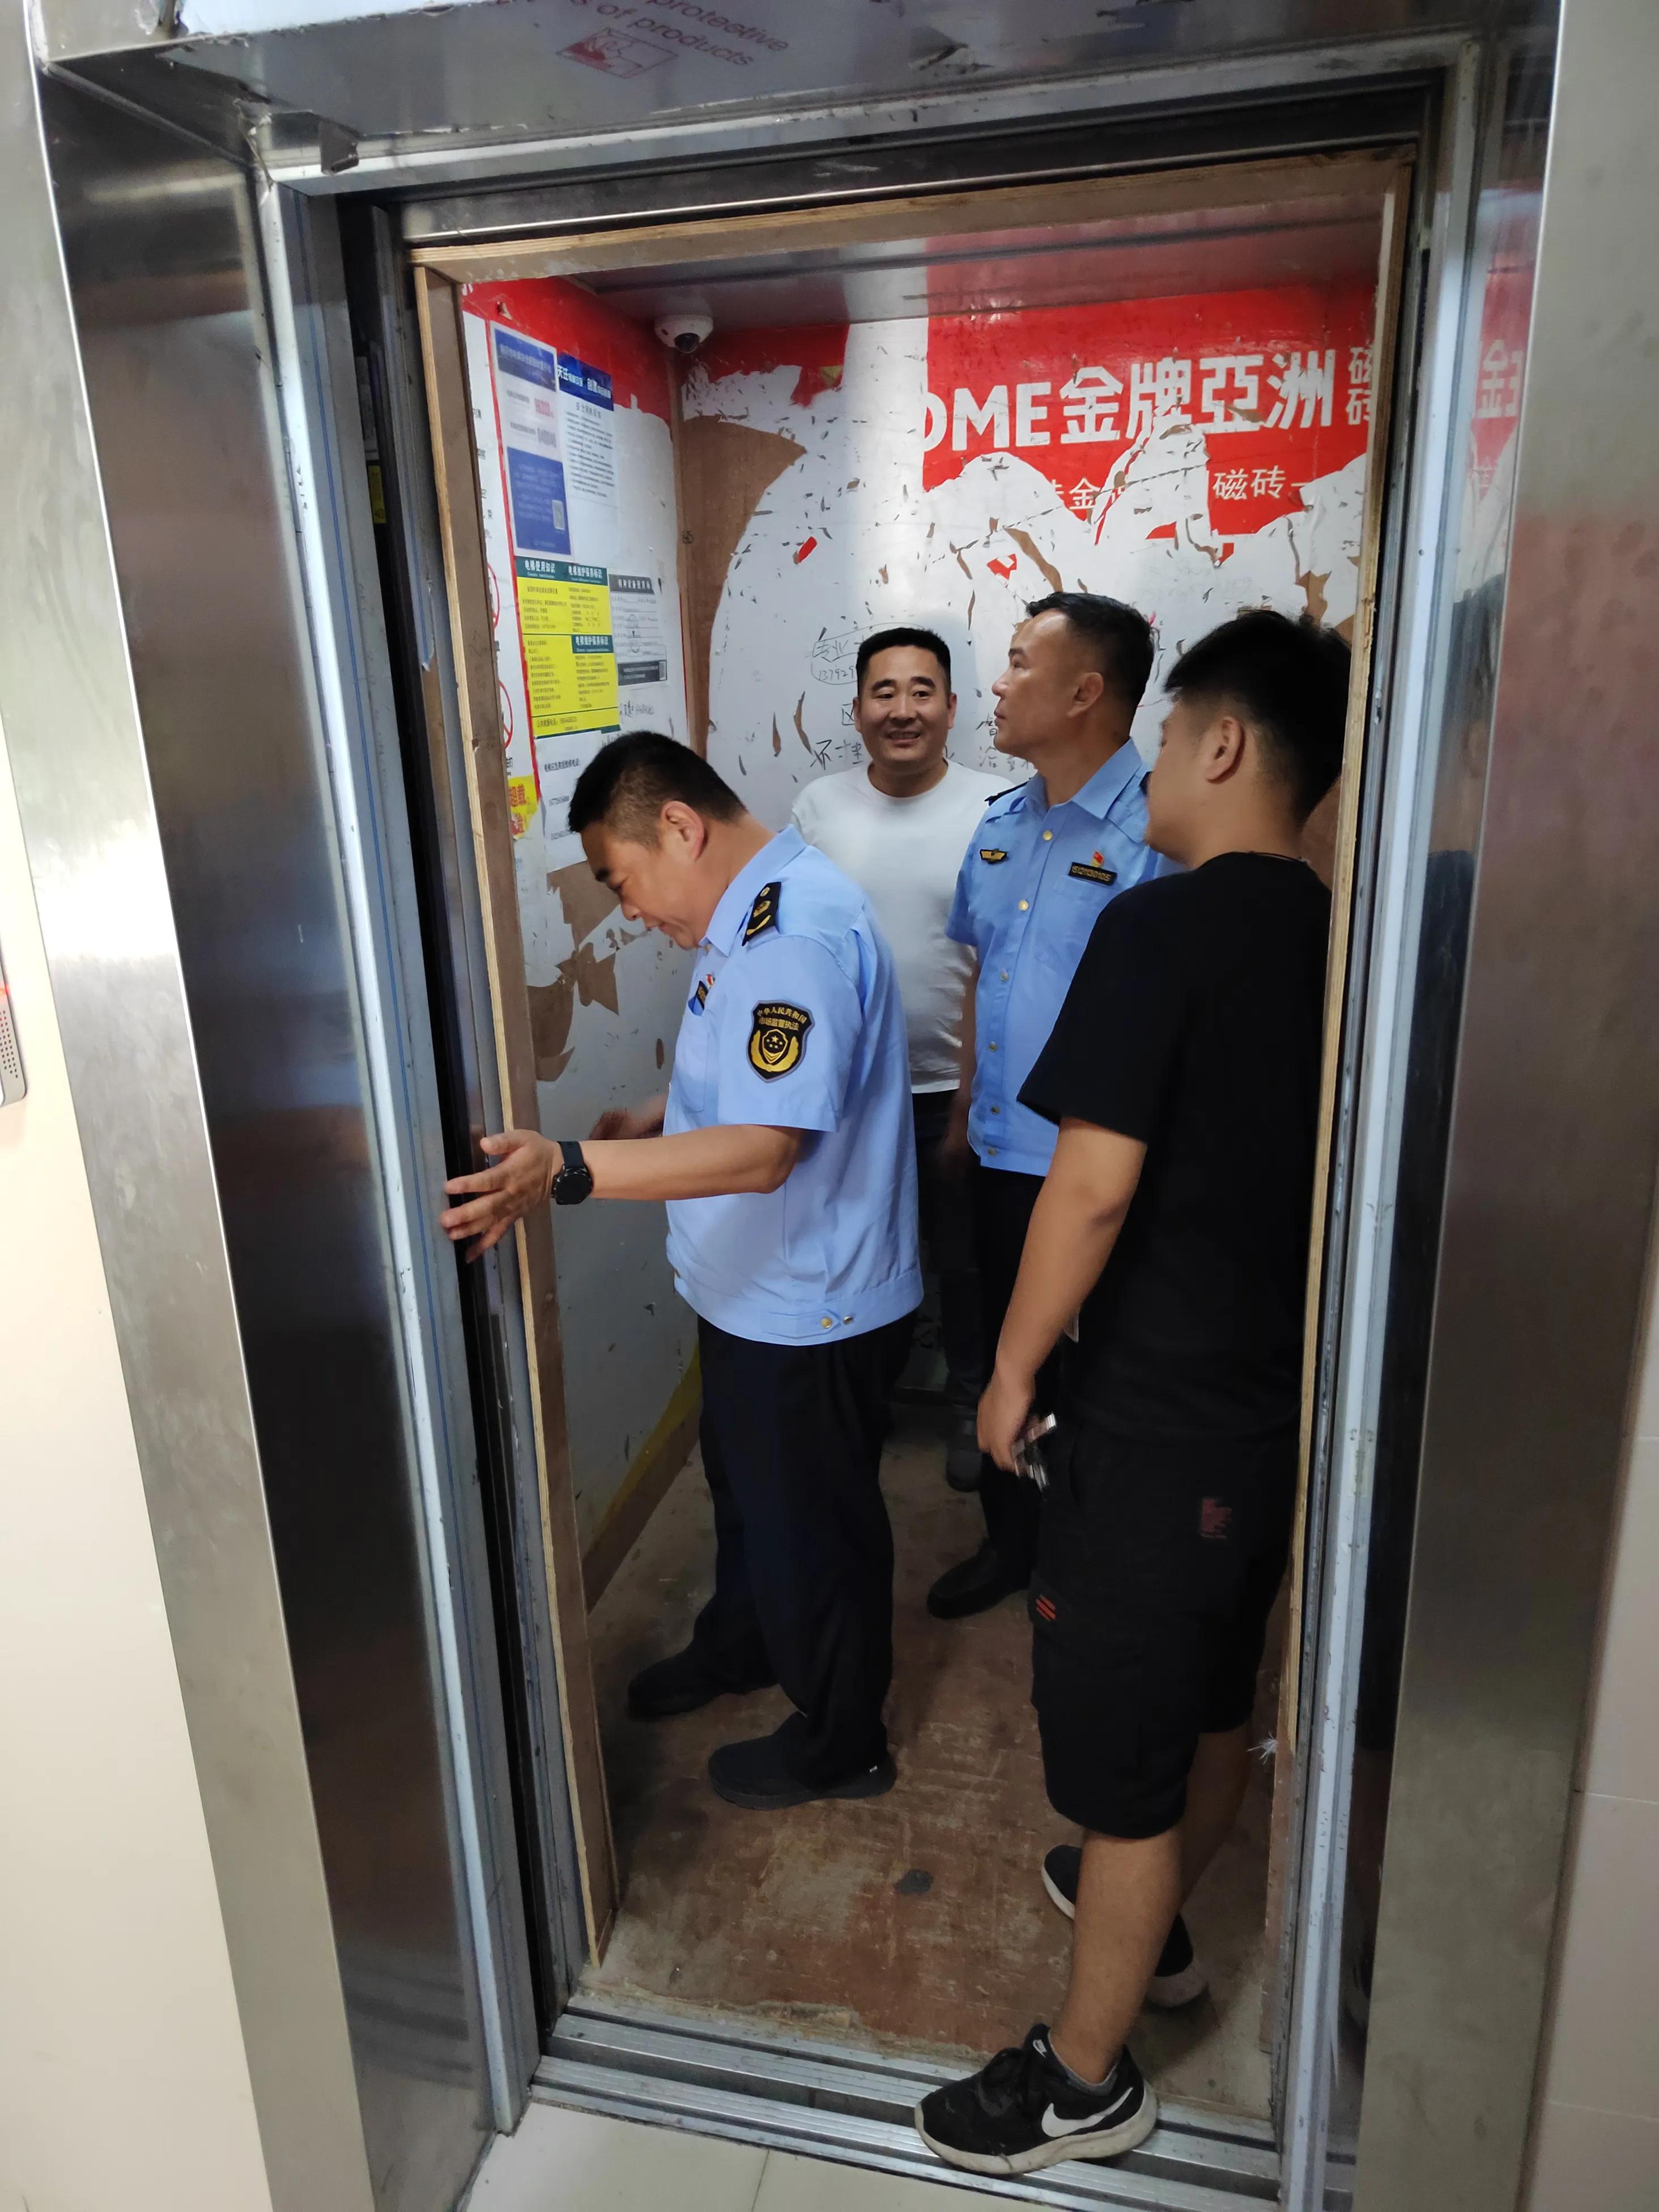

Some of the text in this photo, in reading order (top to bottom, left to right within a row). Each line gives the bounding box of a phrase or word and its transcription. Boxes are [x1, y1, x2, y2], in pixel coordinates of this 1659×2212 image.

[597, 4, 754, 66] of products
[757, 1006, 807, 1024] 中华人民共和国
